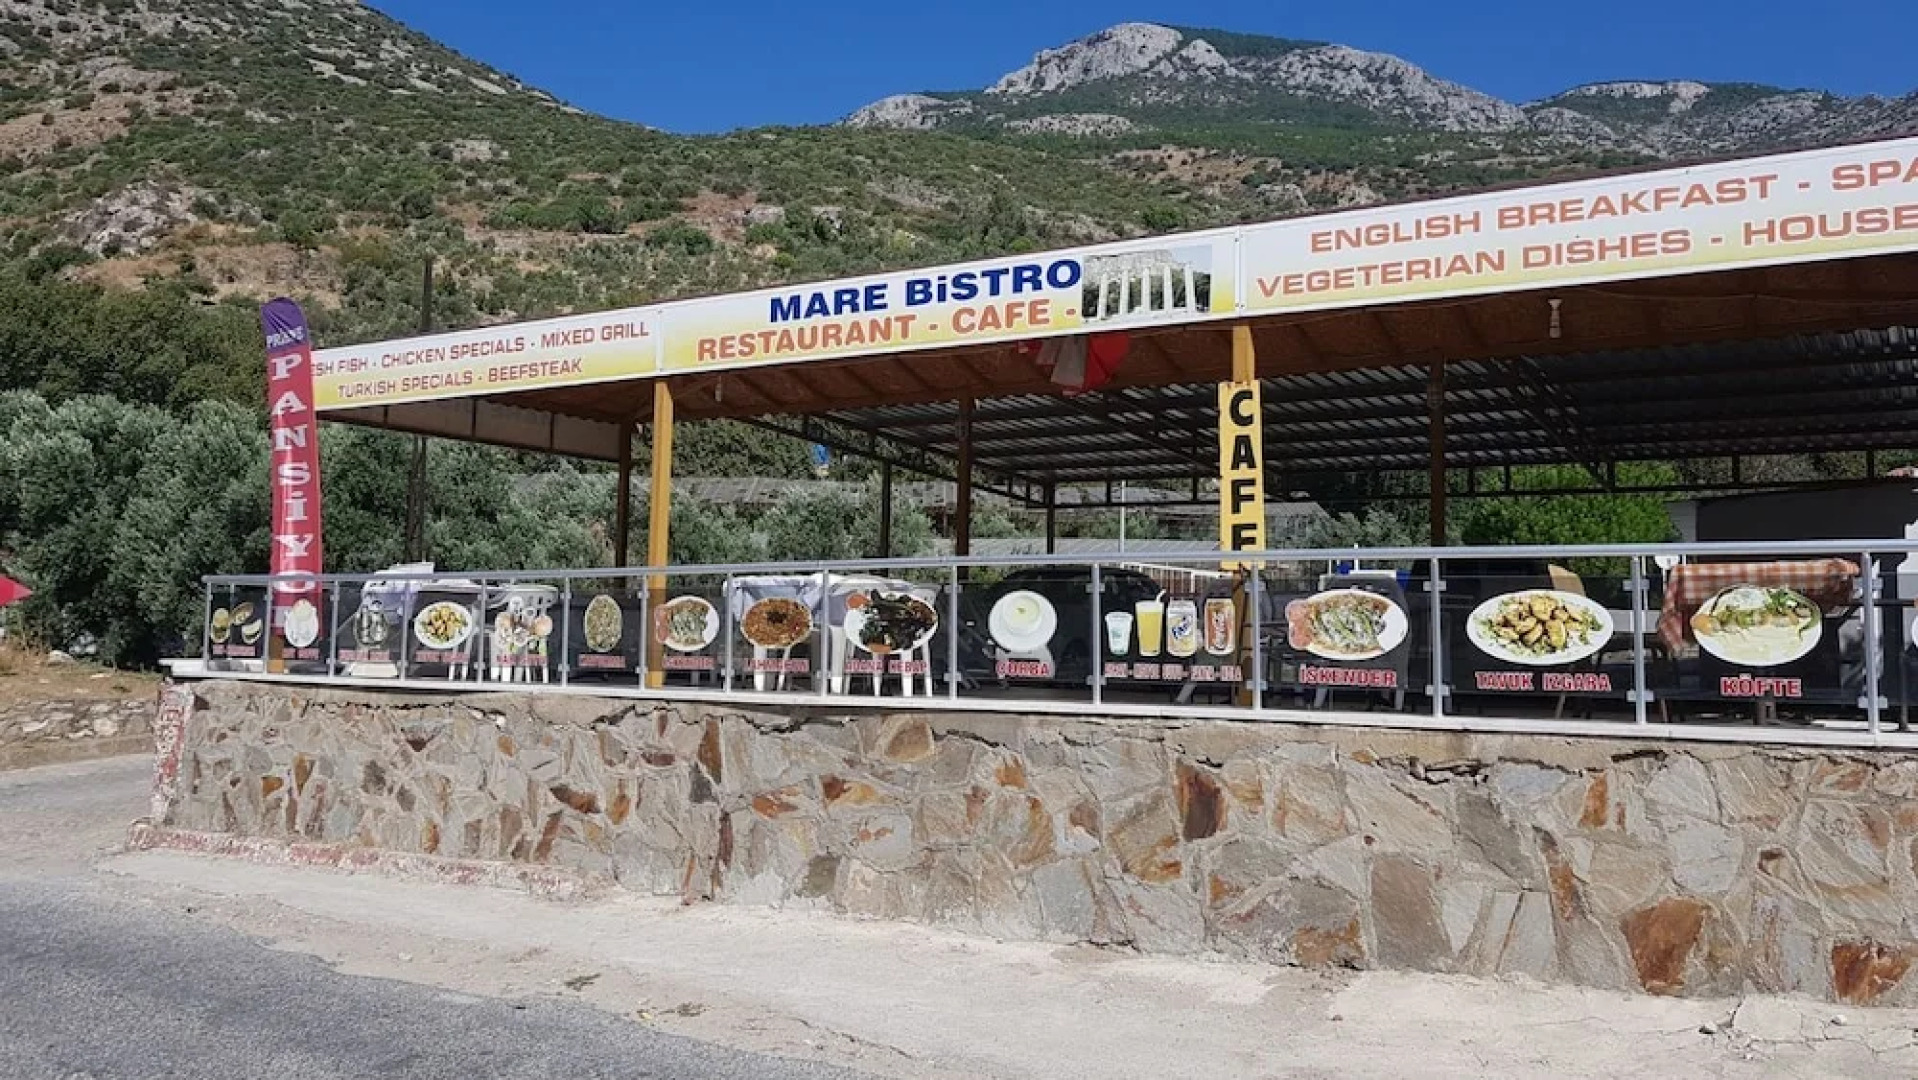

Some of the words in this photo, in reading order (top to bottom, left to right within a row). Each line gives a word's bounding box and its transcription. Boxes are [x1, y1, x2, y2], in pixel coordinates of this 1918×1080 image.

[1311, 211, 1480, 253] ENGLISH
[1497, 173, 1778, 230] BREAKFAST
[1257, 249, 1505, 298] VEGETERIAN
[1522, 230, 1691, 269] DISHES
[1744, 205, 1918, 246] HOUSE
[770, 283, 889, 323] MARE
[338, 356, 369, 373] FISH
[381, 345, 446, 369] CHICKEN
[450, 336, 525, 361] SPECIALS
[601, 321, 650, 341] GRILL
[697, 314, 917, 361] RESTAURANT
[952, 298, 1050, 334] CAFE
[338, 379, 397, 398] TURKISH
[402, 369, 473, 392] SPECIALS
[488, 358, 583, 382] BEEFSTEAK
[1475, 671, 1535, 692] TAVUK
[1720, 673, 1802, 697] KÖFTE
